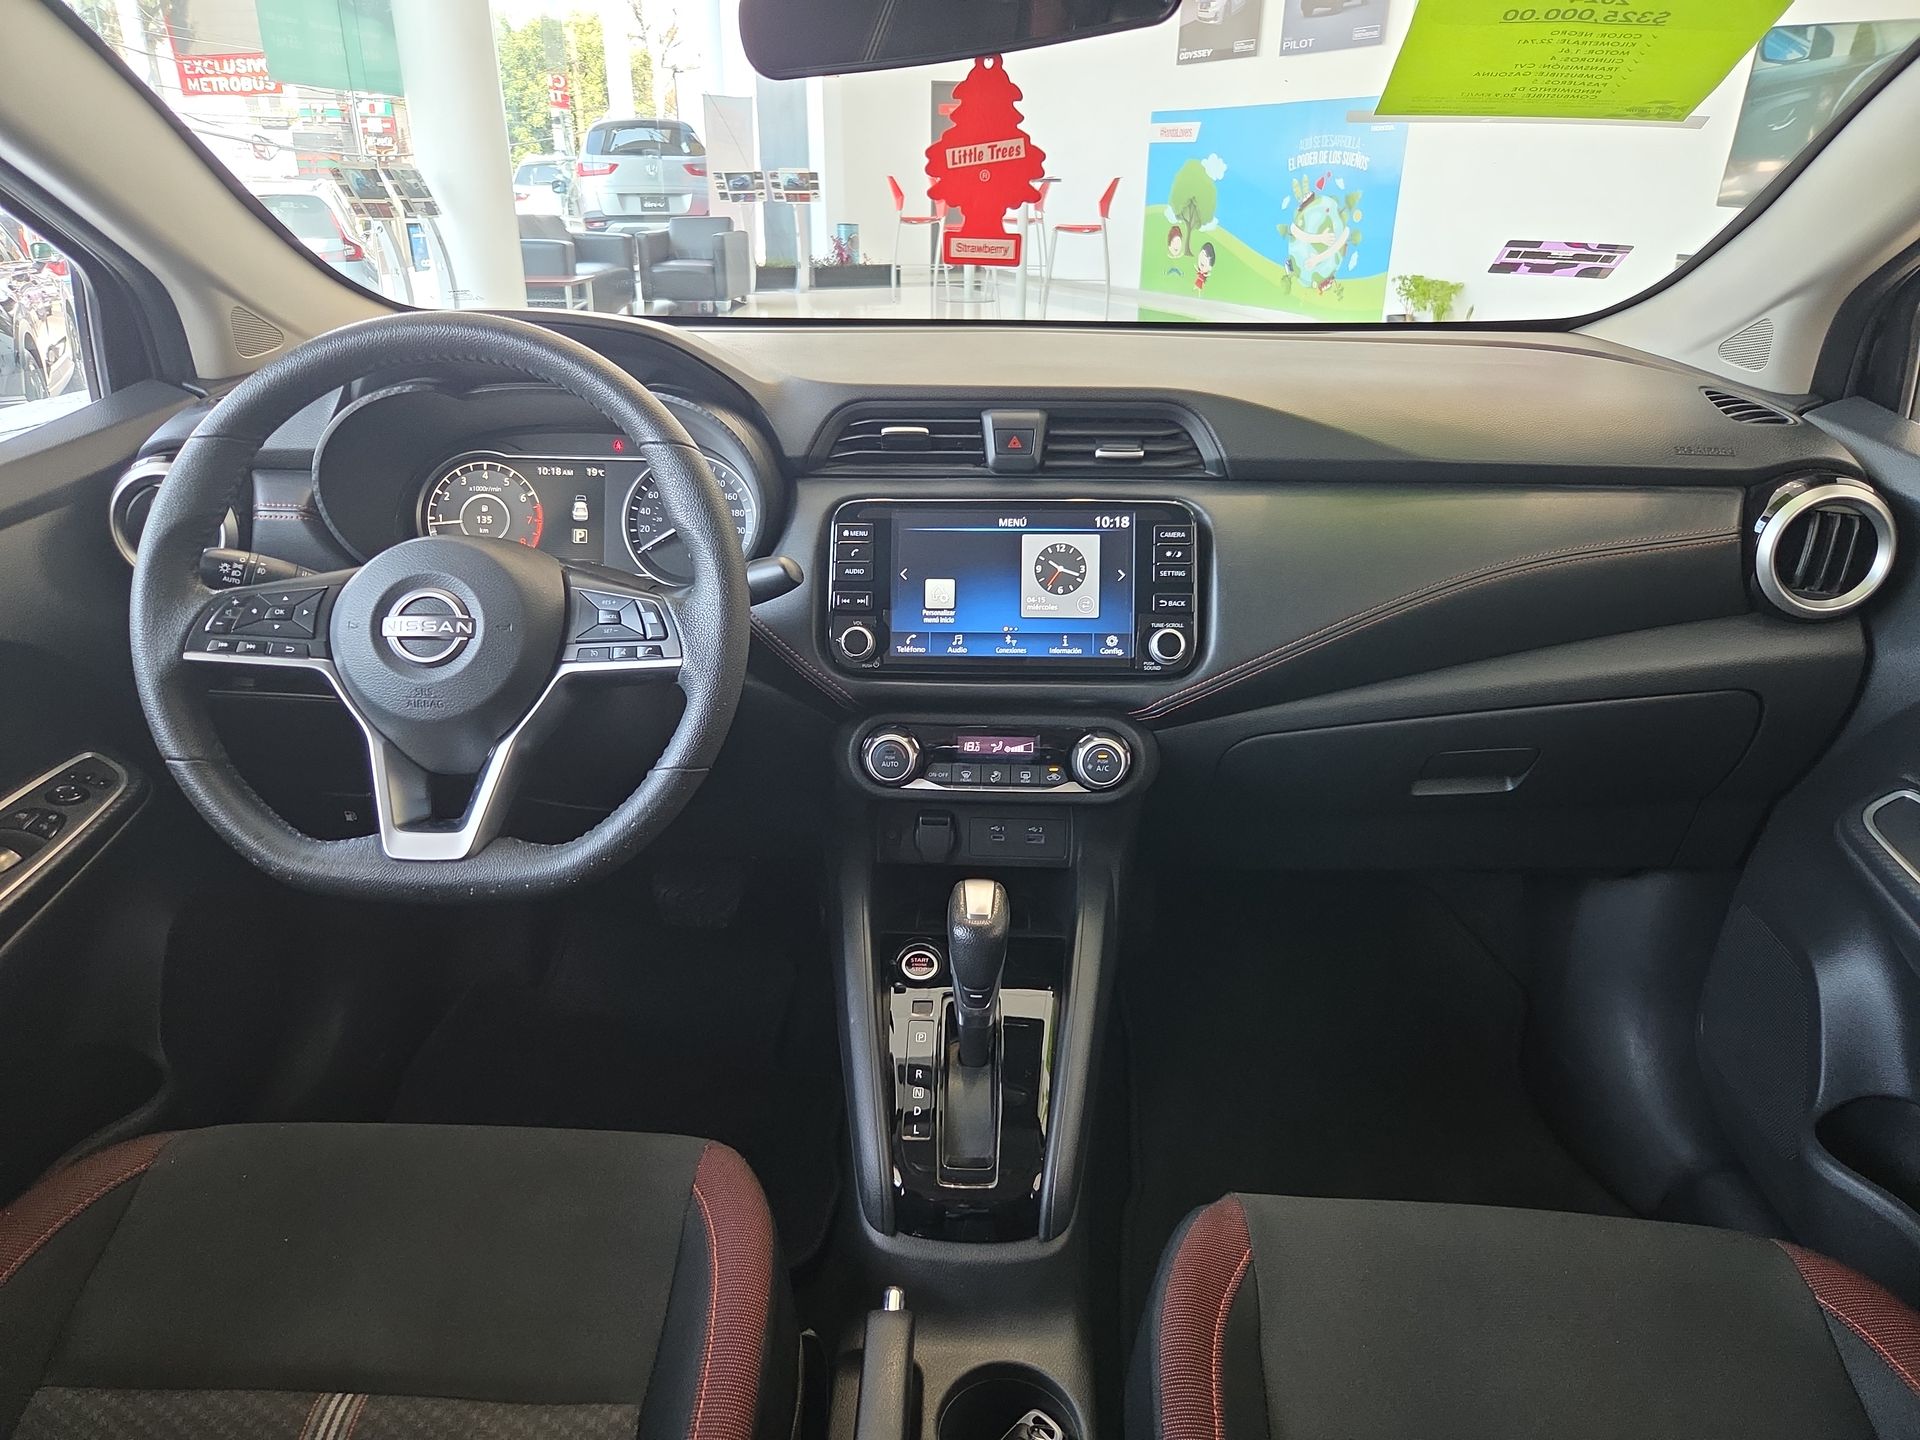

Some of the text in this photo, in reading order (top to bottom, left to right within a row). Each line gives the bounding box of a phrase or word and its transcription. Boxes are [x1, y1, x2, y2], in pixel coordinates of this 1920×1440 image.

[1282, 38, 1316, 50] PILOT
[1178, 48, 1214, 60] ODYSSEY
[183, 57, 269, 75] EXCLUSIV
[186, 75, 276, 93] METROBUS
[951, 144, 1021, 166] Little Trees
[1288, 157, 1296, 172] EL
[1296, 152, 1318, 168] PODER
[1319, 151, 1328, 164] DE
[1328, 151, 1342, 164] LOS
[956, 242, 1010, 256] Strawberry
[482, 470, 489, 480] 4
[537, 466, 562, 476] 10:18
[460, 476, 467, 486] 3
[504, 477, 510, 486] 5
[444, 492, 450, 501] 2
[520, 494, 527, 502] 6
[648, 491, 658, 500] 60
[724, 492, 738, 501] 160
[640, 507, 651, 516] 40
[731, 509, 745, 517] 180
[476, 515, 493, 524] 135
[526, 515, 534, 525] 7
[998, 516, 1028, 528] MENÚ
[1094, 516, 1130, 528] 10:18
[640, 524, 650, 533] 20
[1056, 544, 1066, 552] 12
[1036, 564, 1042, 574] 9
[1080, 565, 1086, 574] 3
[222, 575, 241, 585] AUTO
[1057, 586, 1064, 594] 6
[274, 608, 285, 616] OK
[386, 620, 473, 634] NISSAN
[946, 646, 968, 654] Audio
[406, 698, 444, 709] AIRBAG
[881, 760, 899, 768] AUTO
[915, 1070, 923, 1079] R
[914, 1106, 922, 1116] D
[914, 1125, 920, 1134] L
